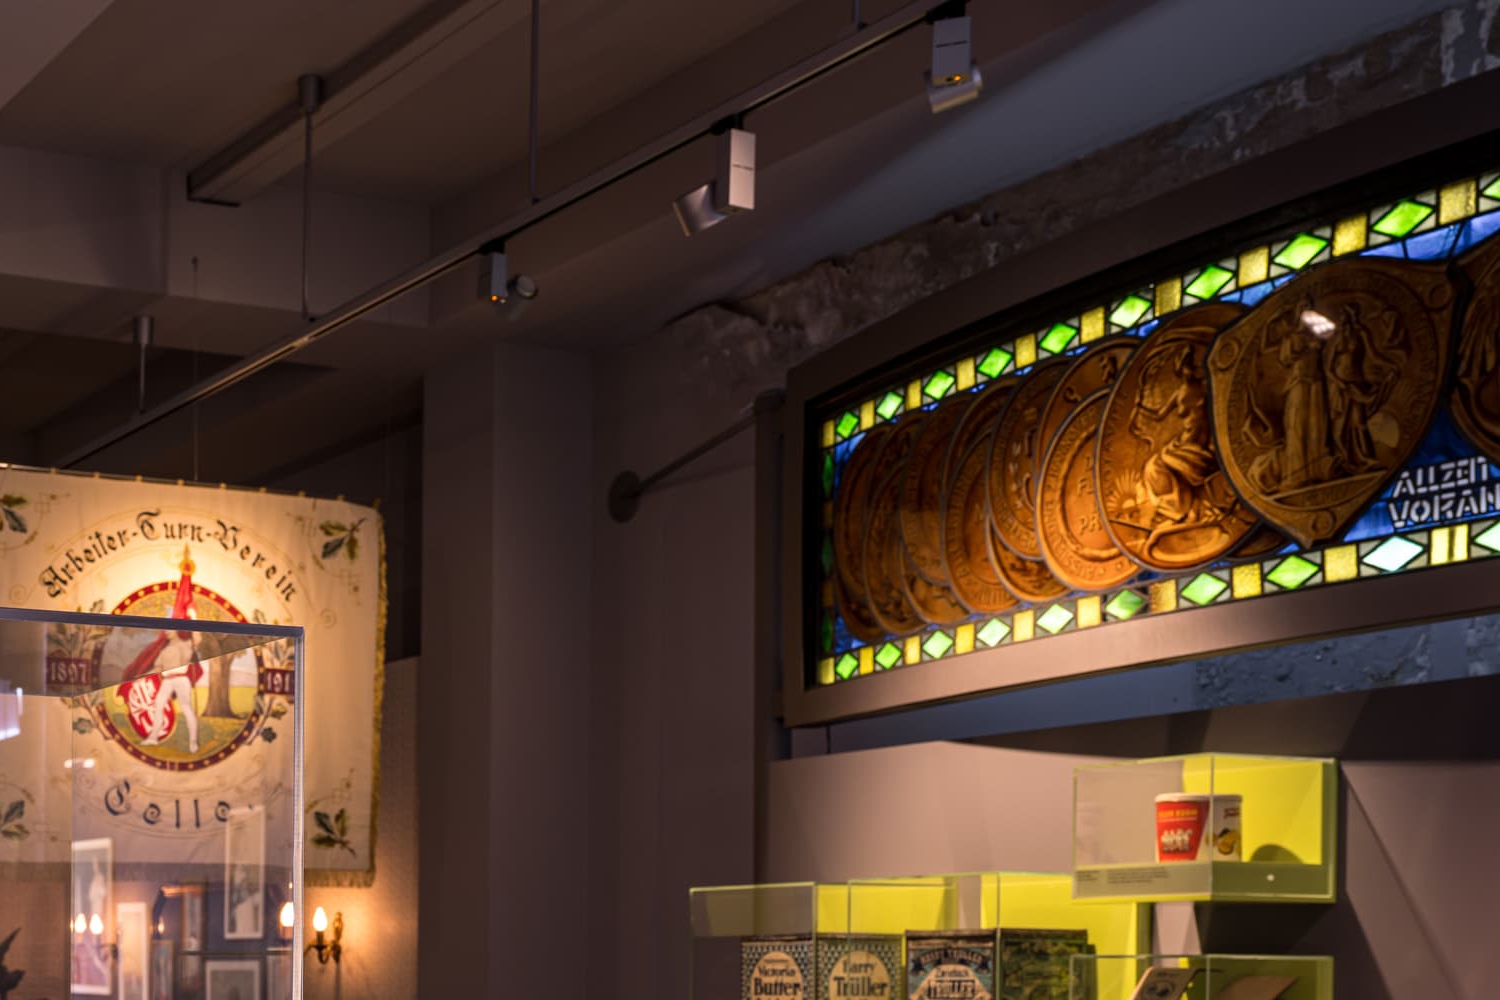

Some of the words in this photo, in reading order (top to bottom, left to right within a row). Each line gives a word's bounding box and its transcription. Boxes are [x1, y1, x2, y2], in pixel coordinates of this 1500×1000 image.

[1393, 456, 1488, 498] ALLZEIT
[1389, 483, 1500, 528] VORAN
[49, 660, 91, 685] 1897
[266, 671, 298, 693] 191
[833, 975, 888, 997] Trüller
